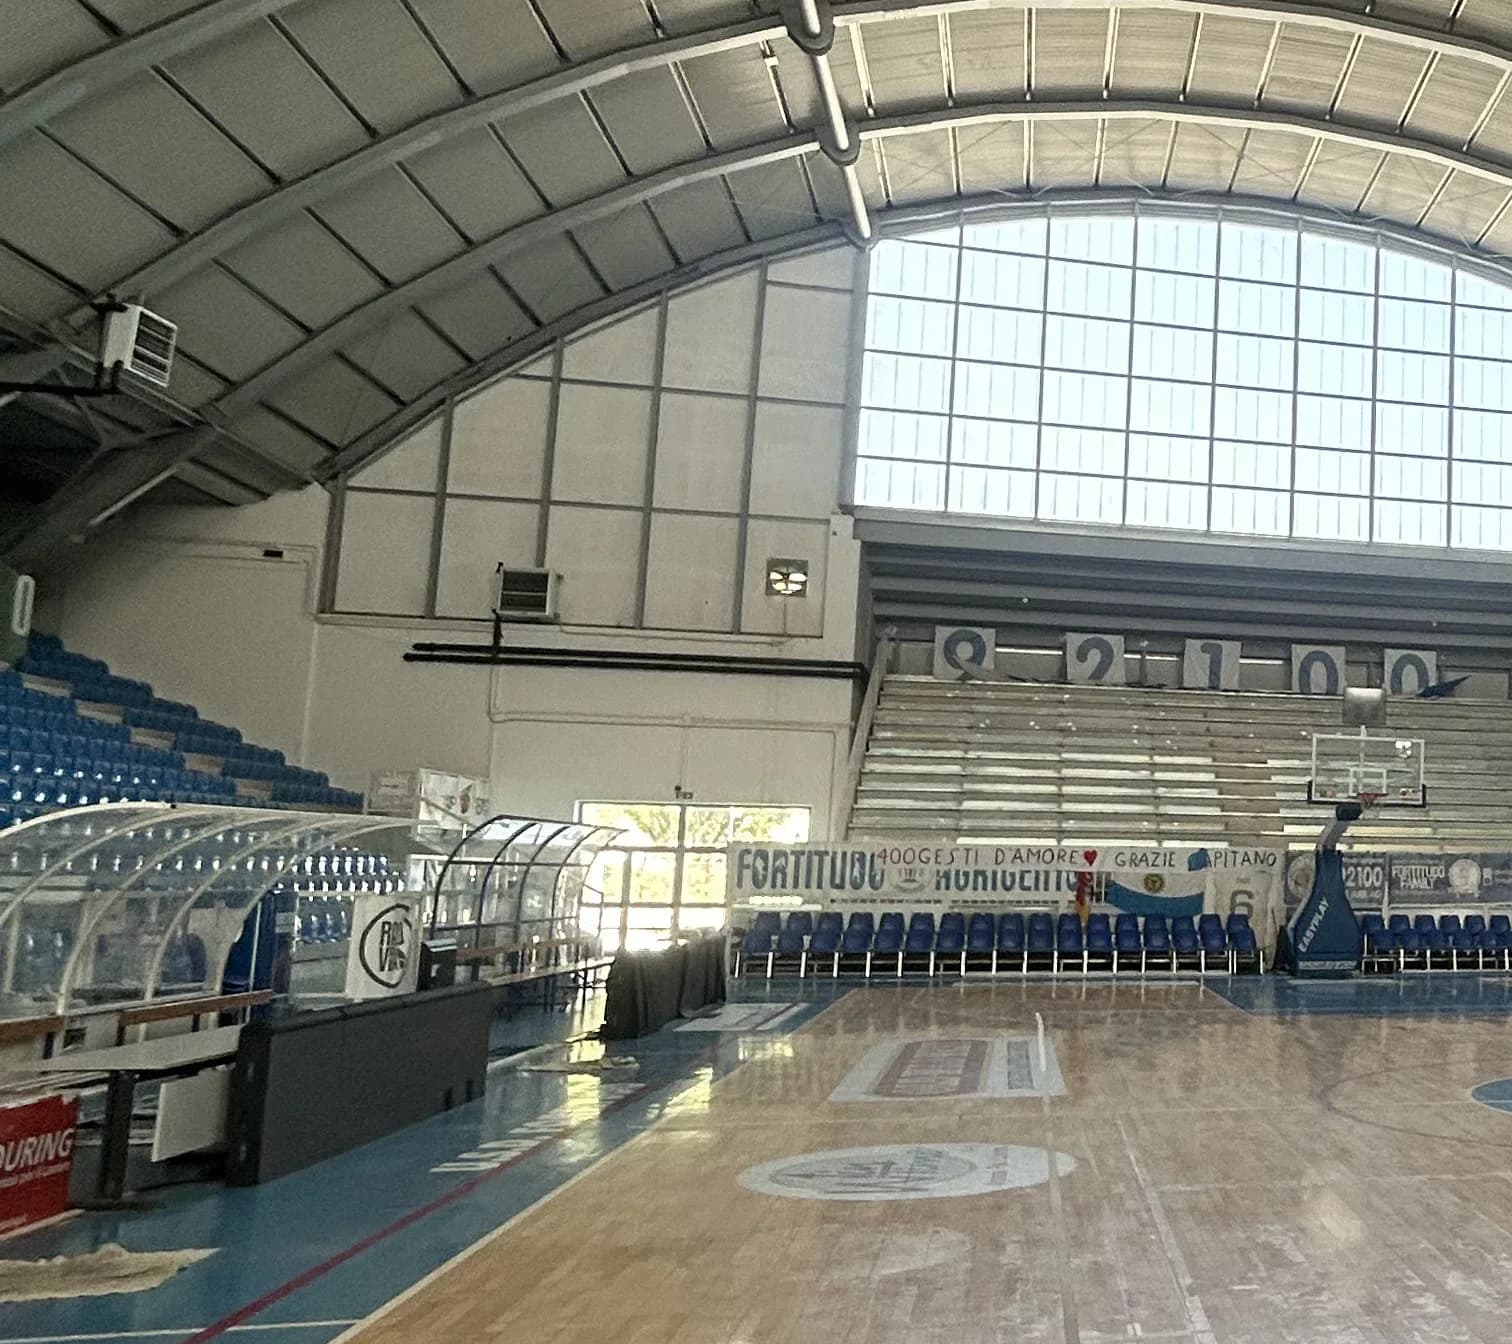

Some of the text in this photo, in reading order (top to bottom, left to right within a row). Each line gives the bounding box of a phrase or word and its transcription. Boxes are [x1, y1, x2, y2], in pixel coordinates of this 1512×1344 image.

[1114, 851, 1177, 868] GRAZIE
[1207, 850, 1277, 868] PITANO
[0, 1127, 75, 1172] URING
